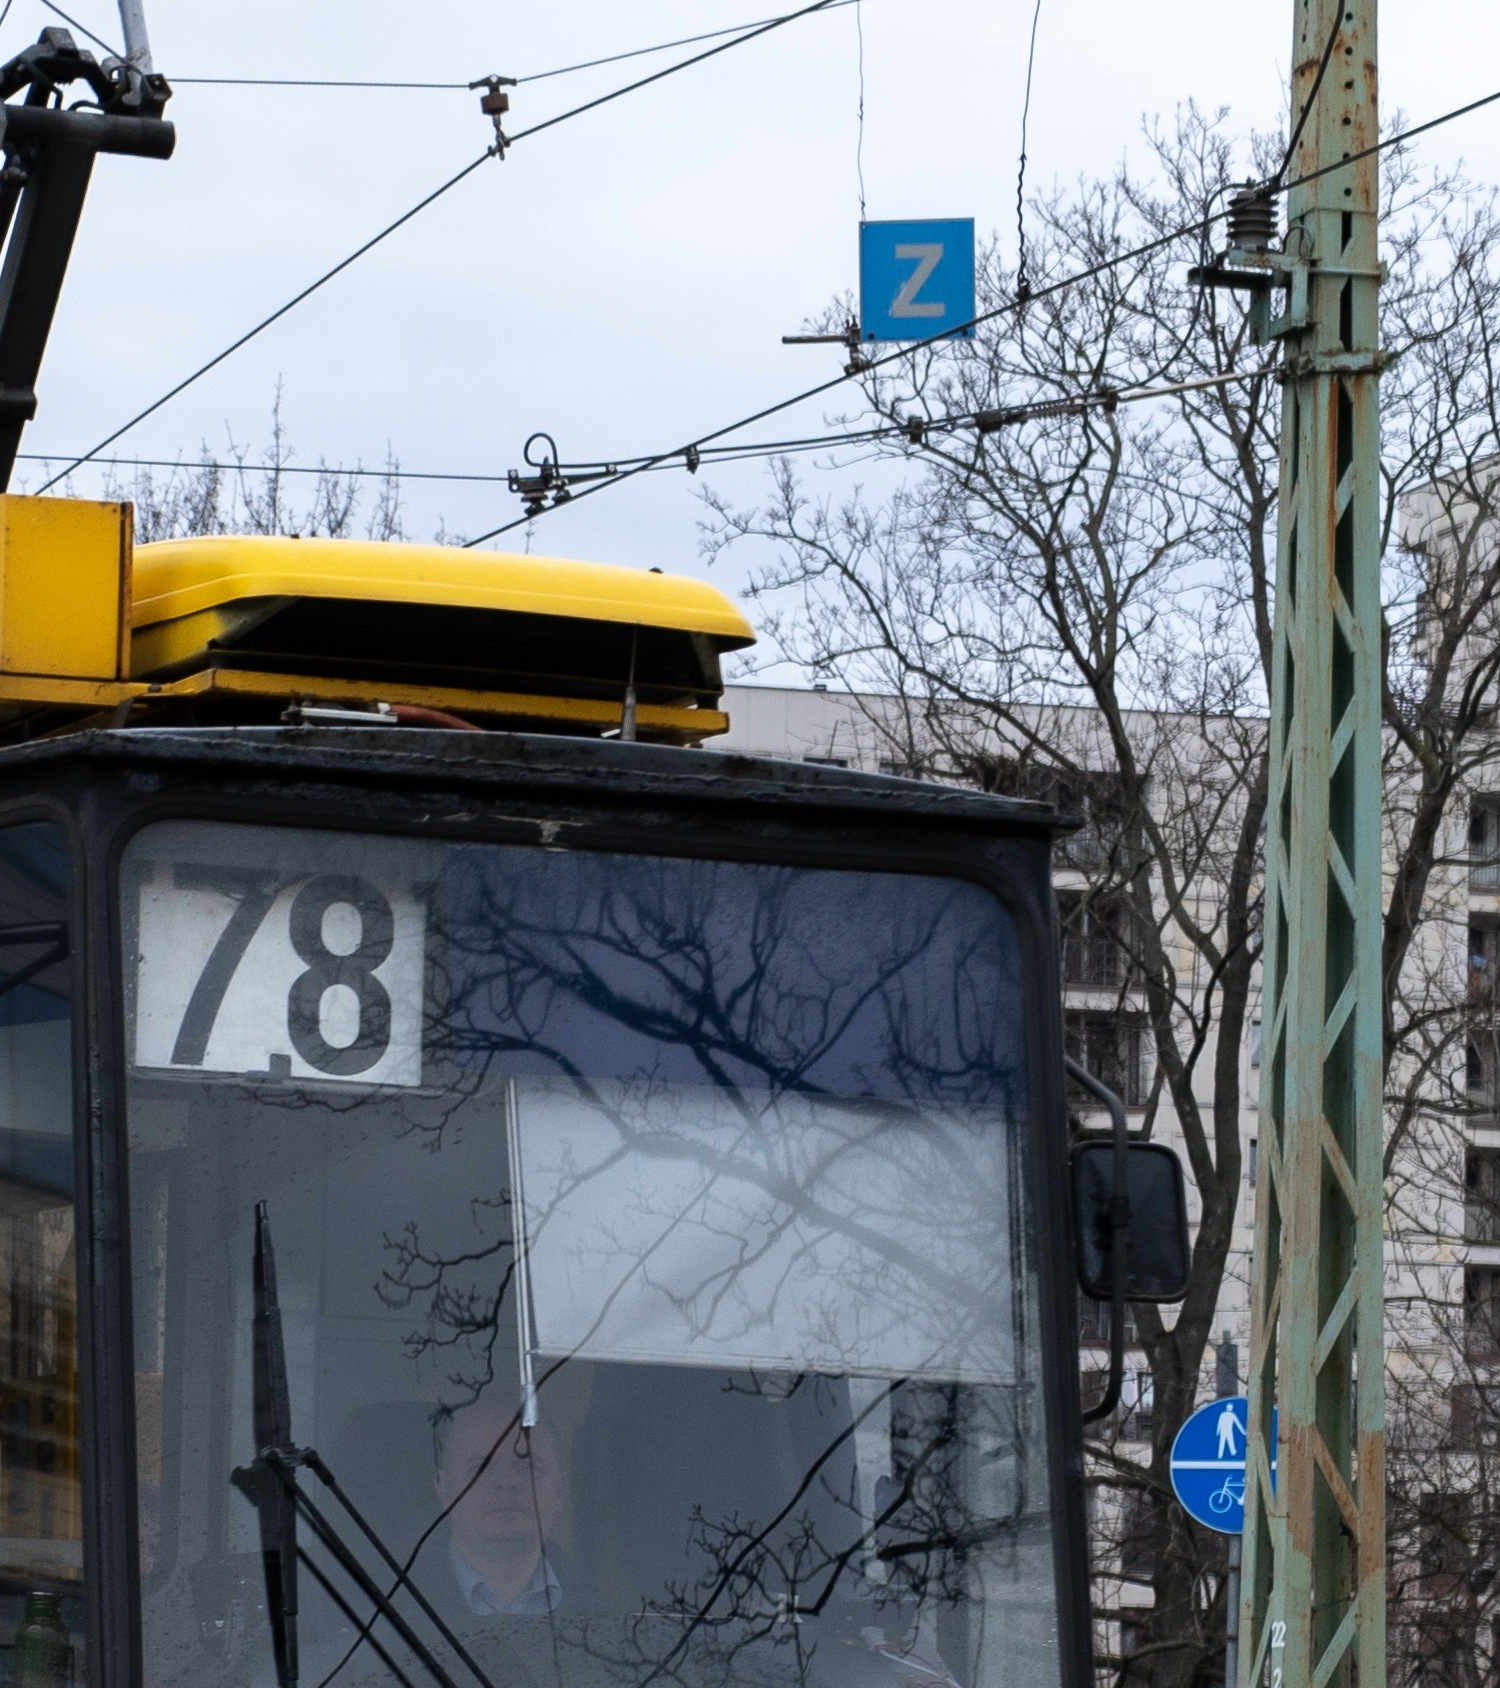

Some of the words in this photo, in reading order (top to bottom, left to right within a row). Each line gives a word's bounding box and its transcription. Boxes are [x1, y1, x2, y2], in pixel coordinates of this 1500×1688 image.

[890, 242, 946, 318] Z
[171, 862, 395, 1076] 78
[1271, 1620, 1286, 1648] 22
